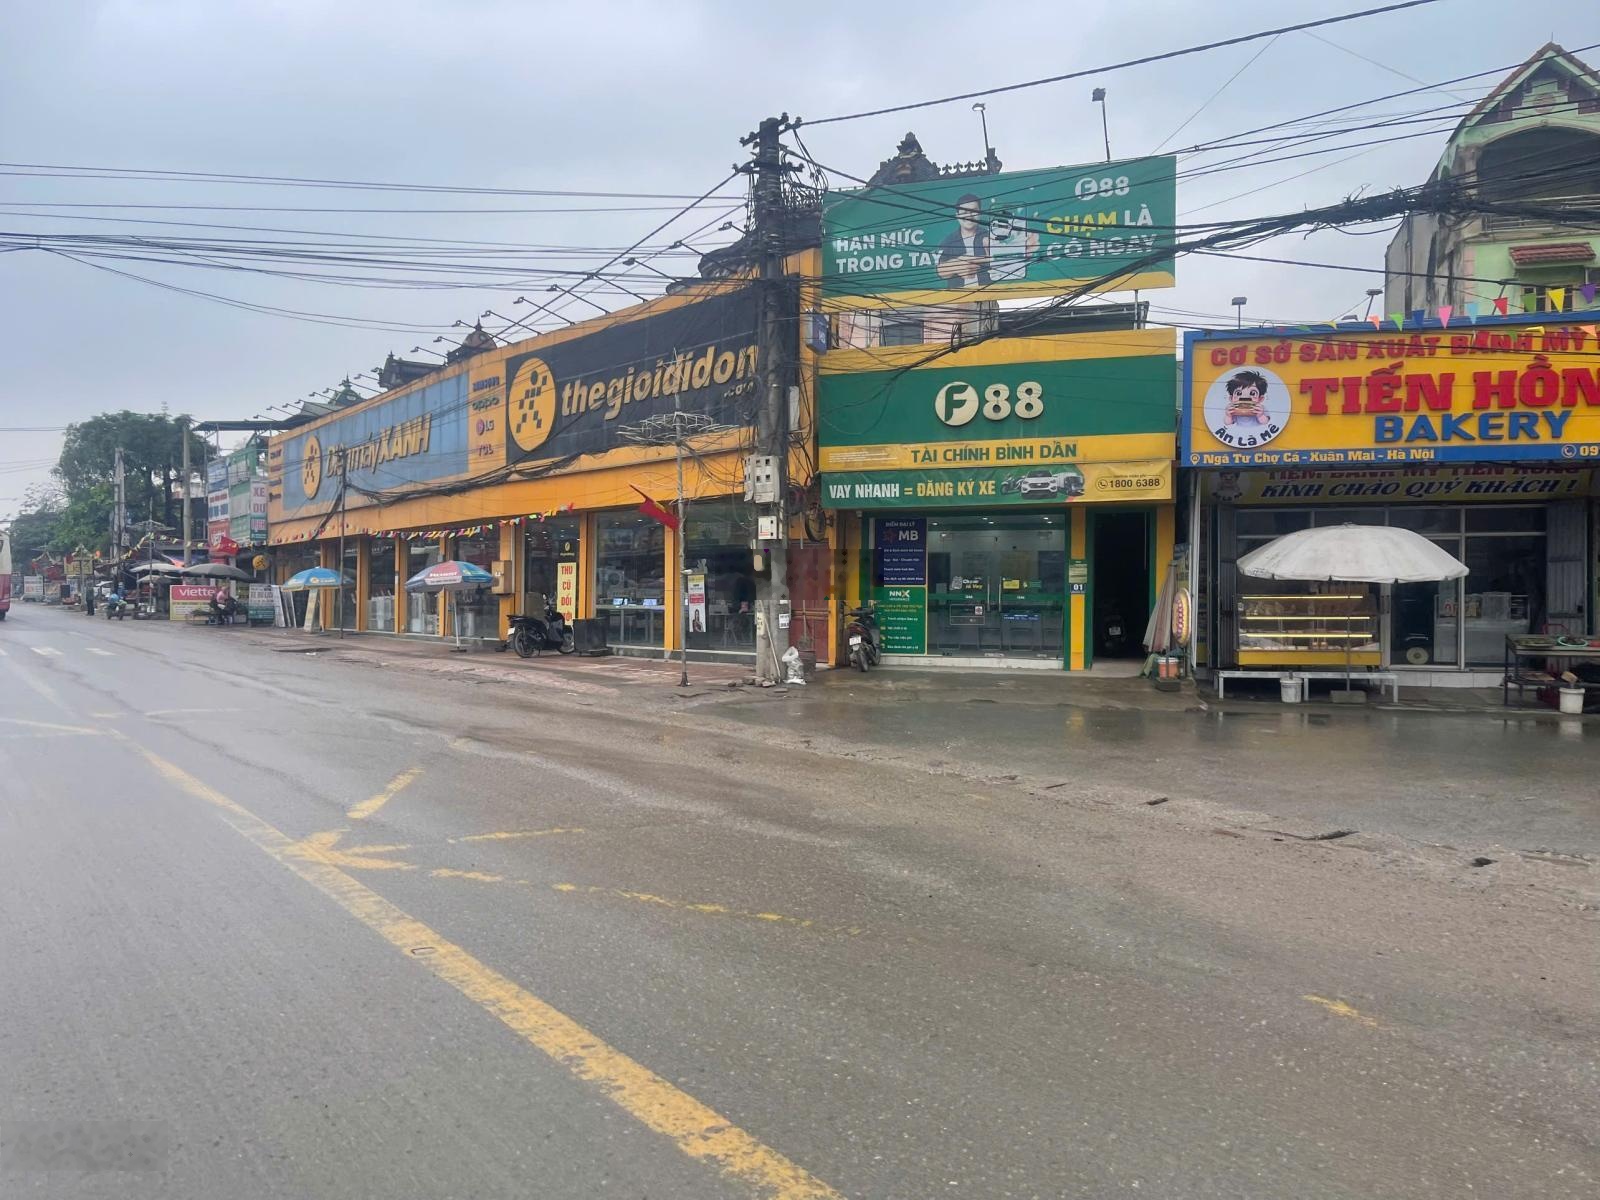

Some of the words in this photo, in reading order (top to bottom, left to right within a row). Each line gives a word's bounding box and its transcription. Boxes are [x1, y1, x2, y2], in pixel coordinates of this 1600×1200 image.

[1075, 176, 1130, 200] F88
[1047, 211, 1117, 237] CHẠM
[1124, 203, 1153, 226] LÀ
[836, 234, 875, 255] HẠN
[881, 228, 925, 248] MỨC
[836, 252, 904, 274] TRONG
[908, 250, 944, 268] TAY
[1211, 344, 1249, 367] CƠ
[1254, 337, 1293, 365] SỞ
[1299, 335, 1358, 362] SẢN
[1450, 329, 1533, 355] BÁNH
[1299, 361, 1456, 415] TIẾN
[1472, 354, 1600, 410] HỒN
[935, 381, 1044, 426] F88
[1214, 425, 1234, 445] Ăn
[1237, 435, 1257, 447] Là
[1259, 423, 1280, 442] Mê
[1375, 410, 1573, 444] BAKERY
[911, 443, 938, 464] TÀI
[943, 444, 990, 462] CHÍNH
[996, 442, 1033, 461] BÌNH
[1203, 453, 1230, 466] Ngã
[1233, 453, 1251, 464] Tư
[1254, 452, 1280, 465] Chợ
[1283, 451, 1300, 463] Cá
[1310, 450, 1344, 463] Xuân
[1348, 449, 1376, 461] Mai
[1387, 448, 1406, 460] Hà
[1410, 448, 1435, 461] Nội
[829, 484, 852, 499] VAY
[855, 483, 900, 498] NHANH
[917, 480, 953, 497] ĐĂNG
[957, 478, 974, 496] KÝ
[979, 480, 996, 495] XE
[1109, 479, 1133, 488] 1800
[1136, 478, 1161, 487] 6388
[1260, 480, 1325, 498] KÍNH
[1328, 479, 1399, 497] CHÀO
[1405, 478, 1463, 498] QUÝ
[1464, 477, 1562, 494] KHÁCH
[898, 530, 919, 541] MB
[561, 565, 573, 575] THU
[179, 587, 217, 597] viette
[889, 590, 911, 598] NNX
[1073, 583, 1083, 591] 01
